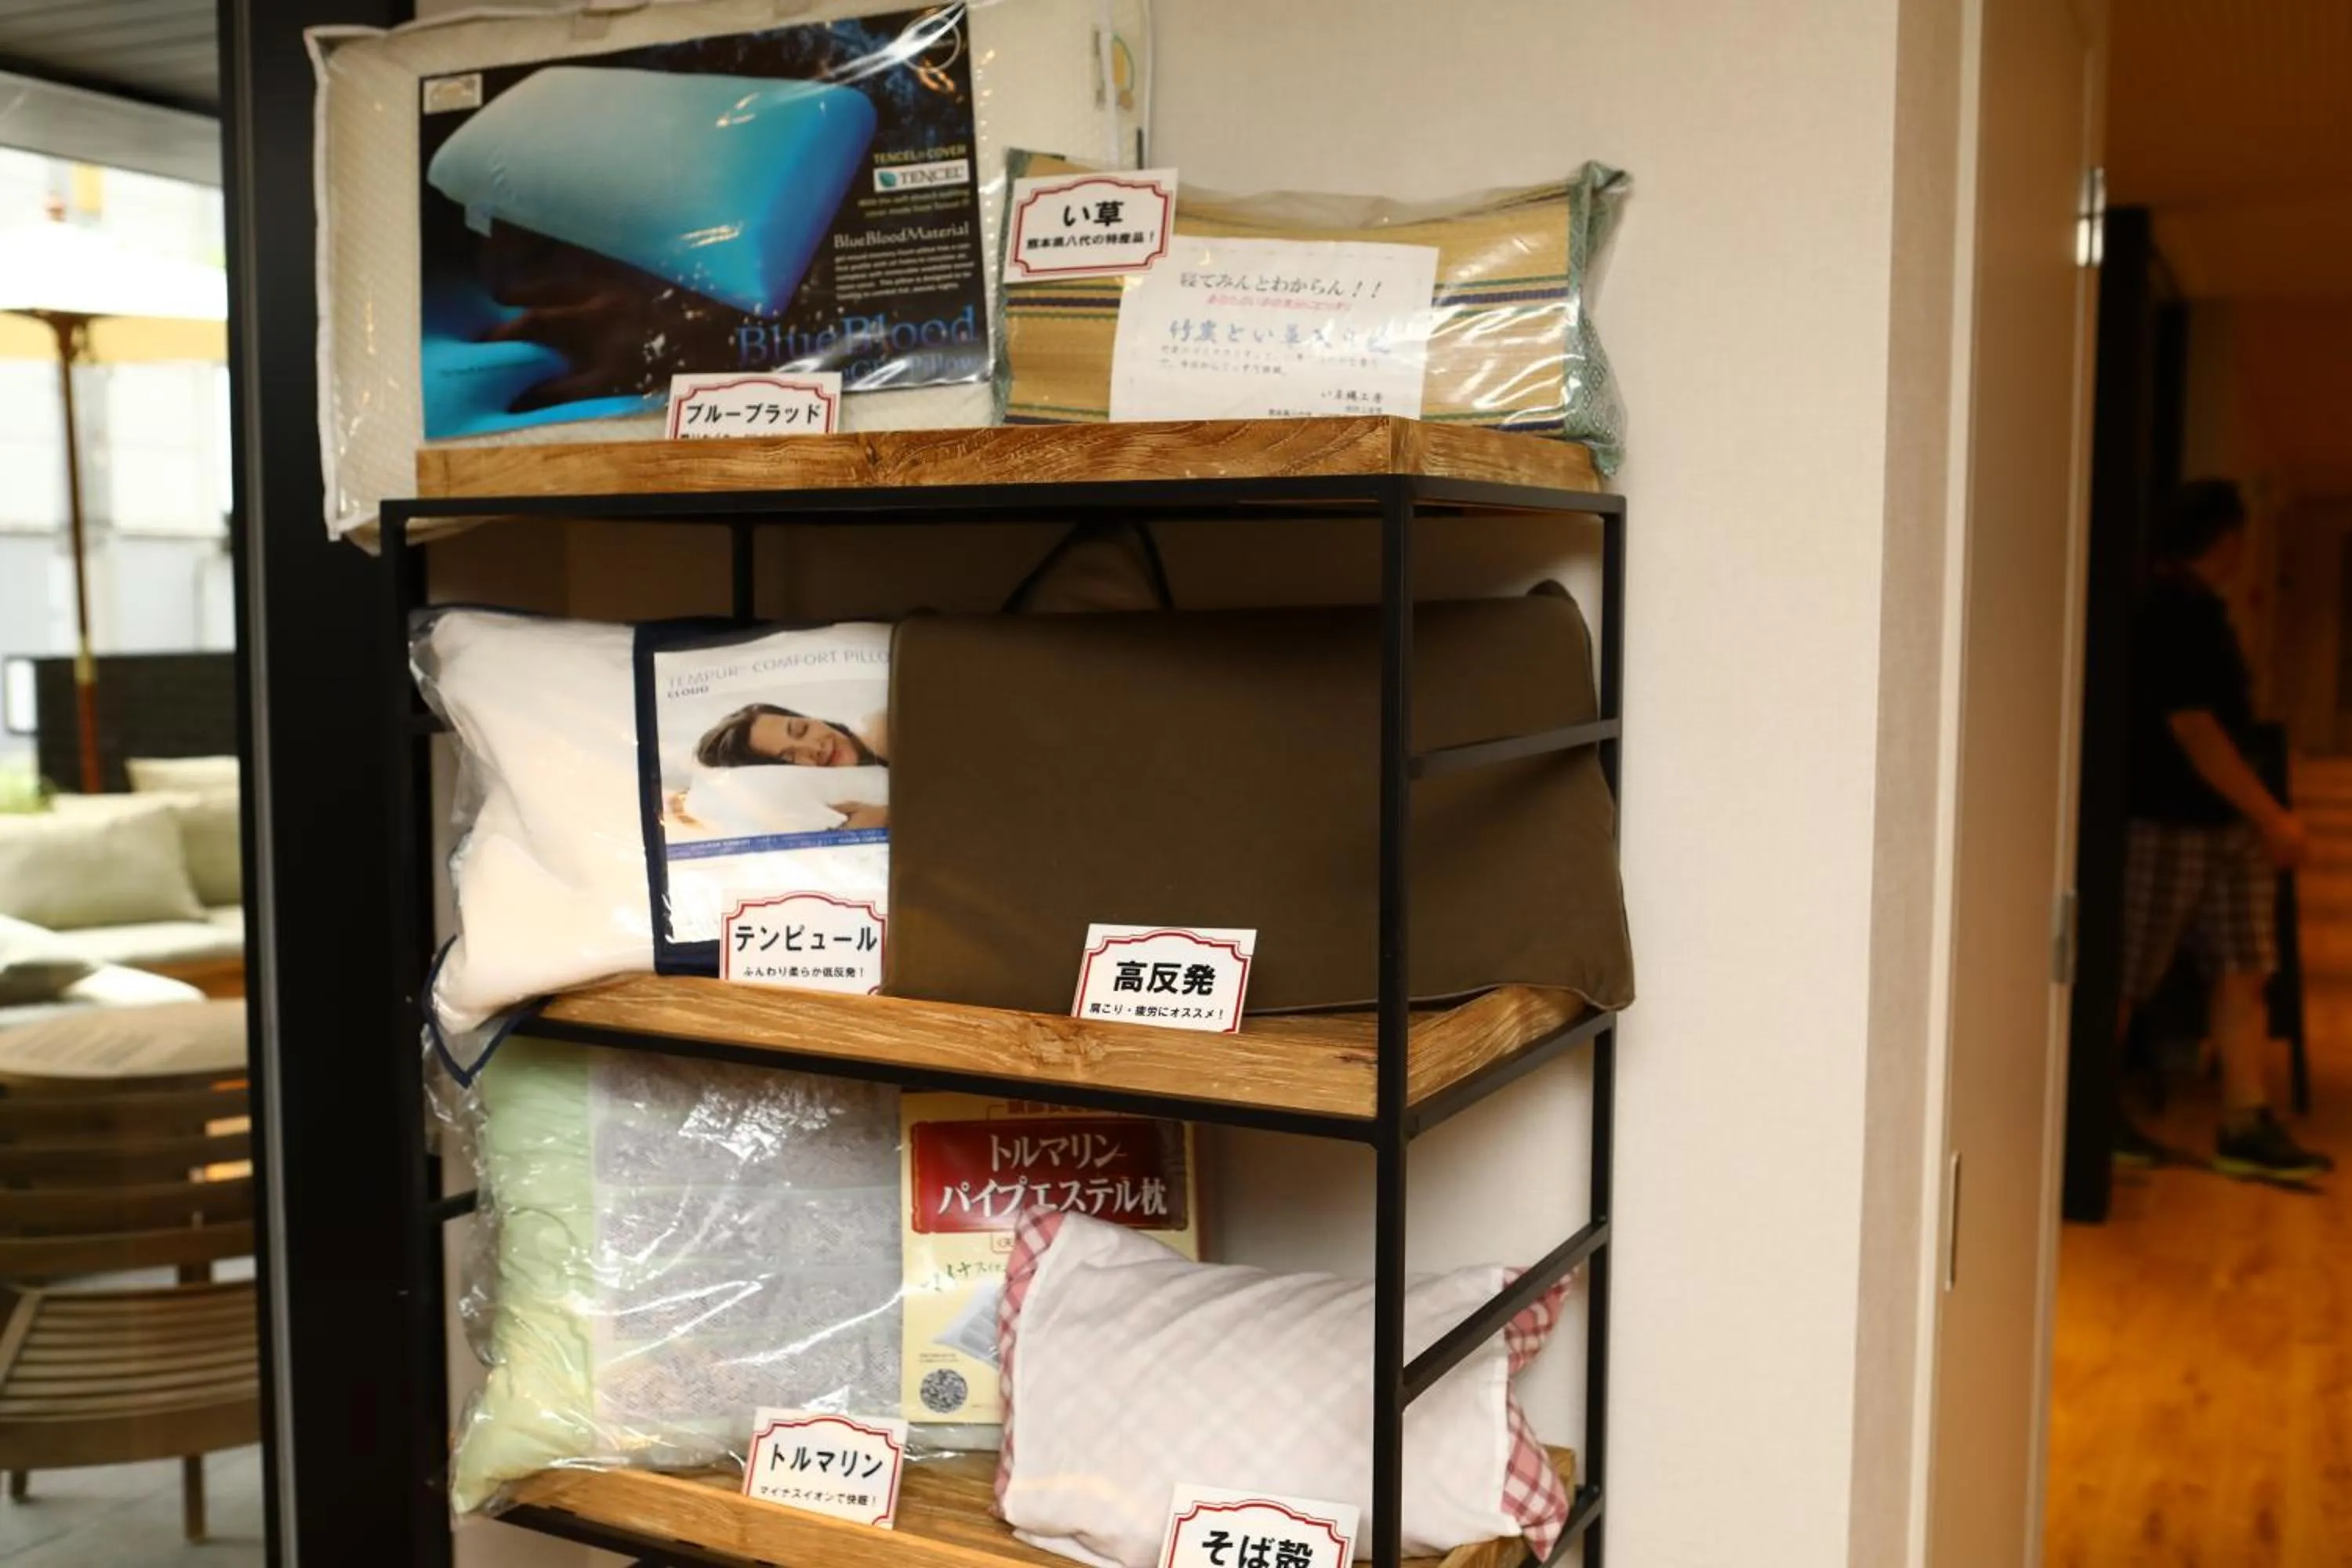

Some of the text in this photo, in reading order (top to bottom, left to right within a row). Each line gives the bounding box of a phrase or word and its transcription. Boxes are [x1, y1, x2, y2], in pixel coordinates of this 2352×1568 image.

[1063, 201, 1124, 227] い草
[686, 402, 821, 424] ブルーブラッド
[735, 924, 878, 952] テンピュール
[1112, 960, 1216, 996] 高反発
[989, 1133, 1123, 1172] トルマリン
[938, 1174, 1168, 1218] パイプエステル枕
[770, 1443, 884, 1479] トルマリン
[1202, 1530, 1313, 1568] そば殻
